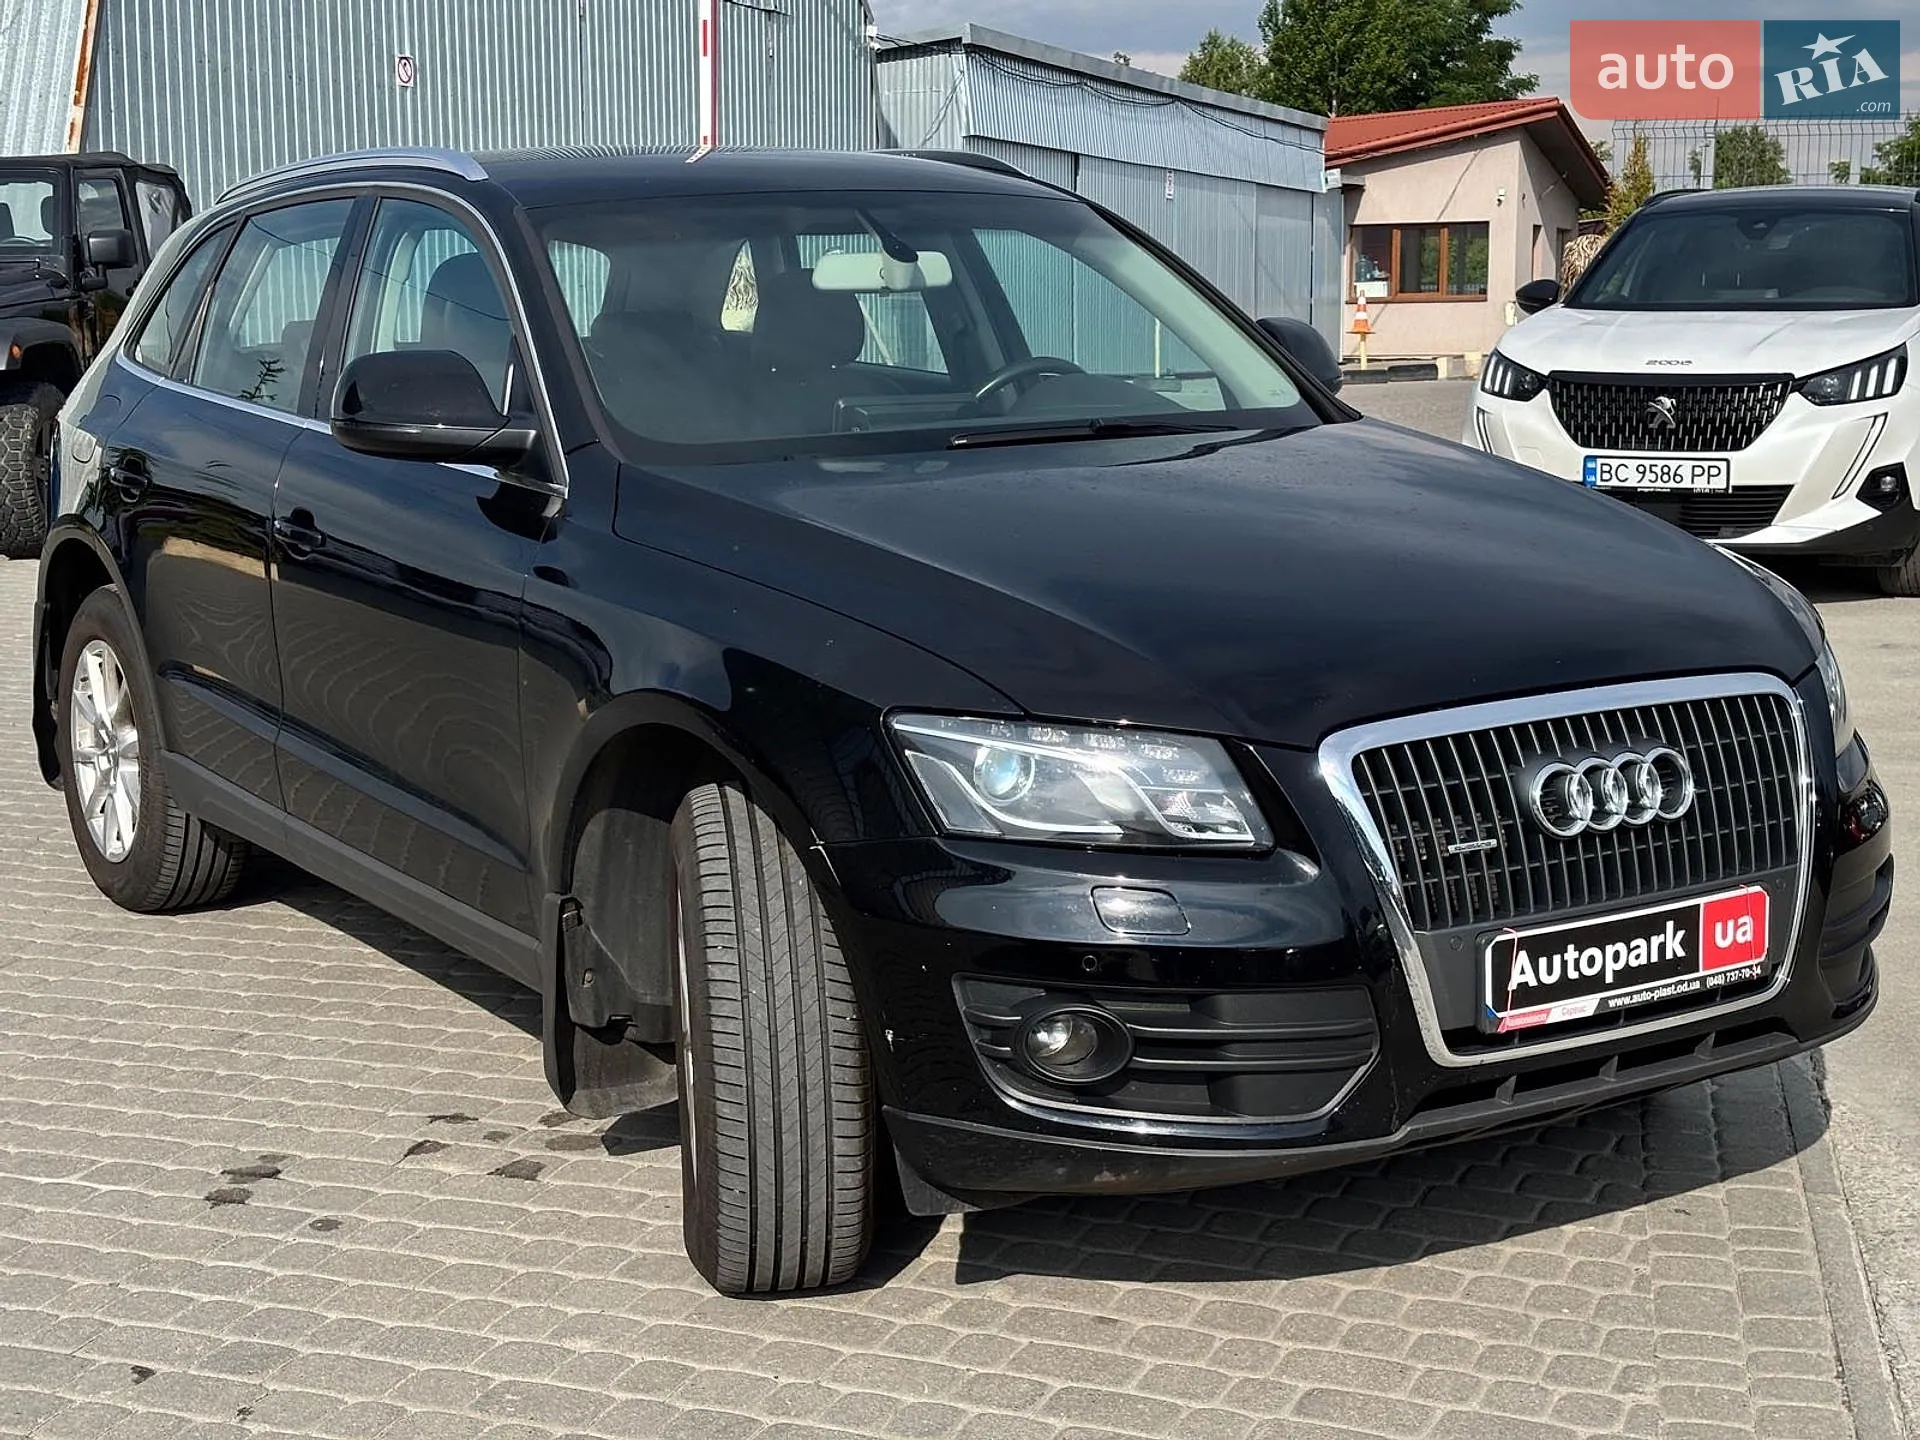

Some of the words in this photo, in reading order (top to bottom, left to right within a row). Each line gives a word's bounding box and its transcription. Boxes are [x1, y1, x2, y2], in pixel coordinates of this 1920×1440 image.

[1600, 463, 1629, 483] BC
[1636, 463, 1684, 484] 9586
[1691, 464, 1722, 485] PP
[1510, 920, 1686, 990] Autopark
[1714, 913, 1754, 949] ua
